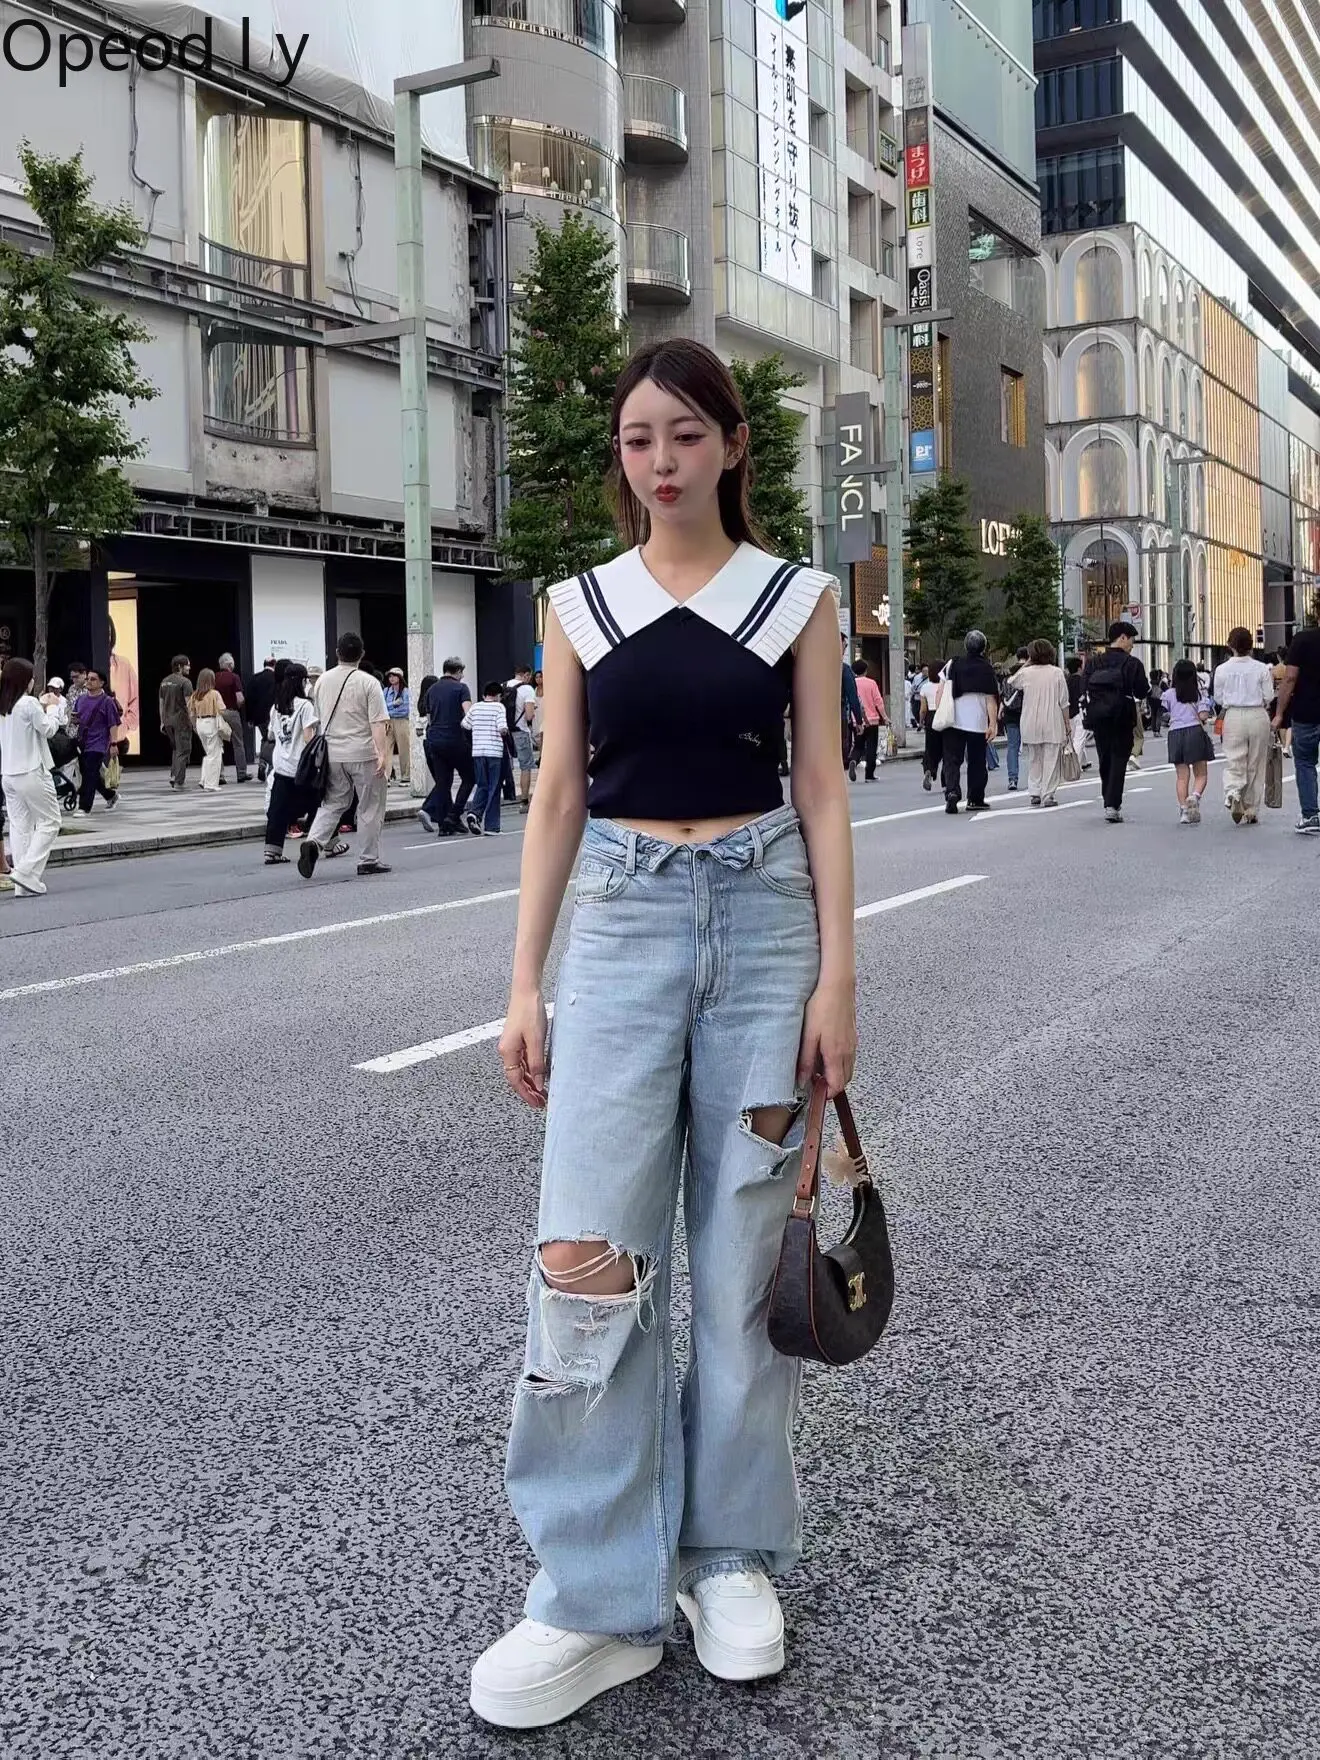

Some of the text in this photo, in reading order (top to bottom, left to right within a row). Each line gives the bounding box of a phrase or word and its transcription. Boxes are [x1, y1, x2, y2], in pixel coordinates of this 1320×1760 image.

[911, 145, 926, 179] まつげ
[912, 191, 928, 224] 歯科
[917, 269, 931, 306] Oasis
[839, 423, 864, 532] FANCL
[1088, 583, 1124, 597] FENDI
